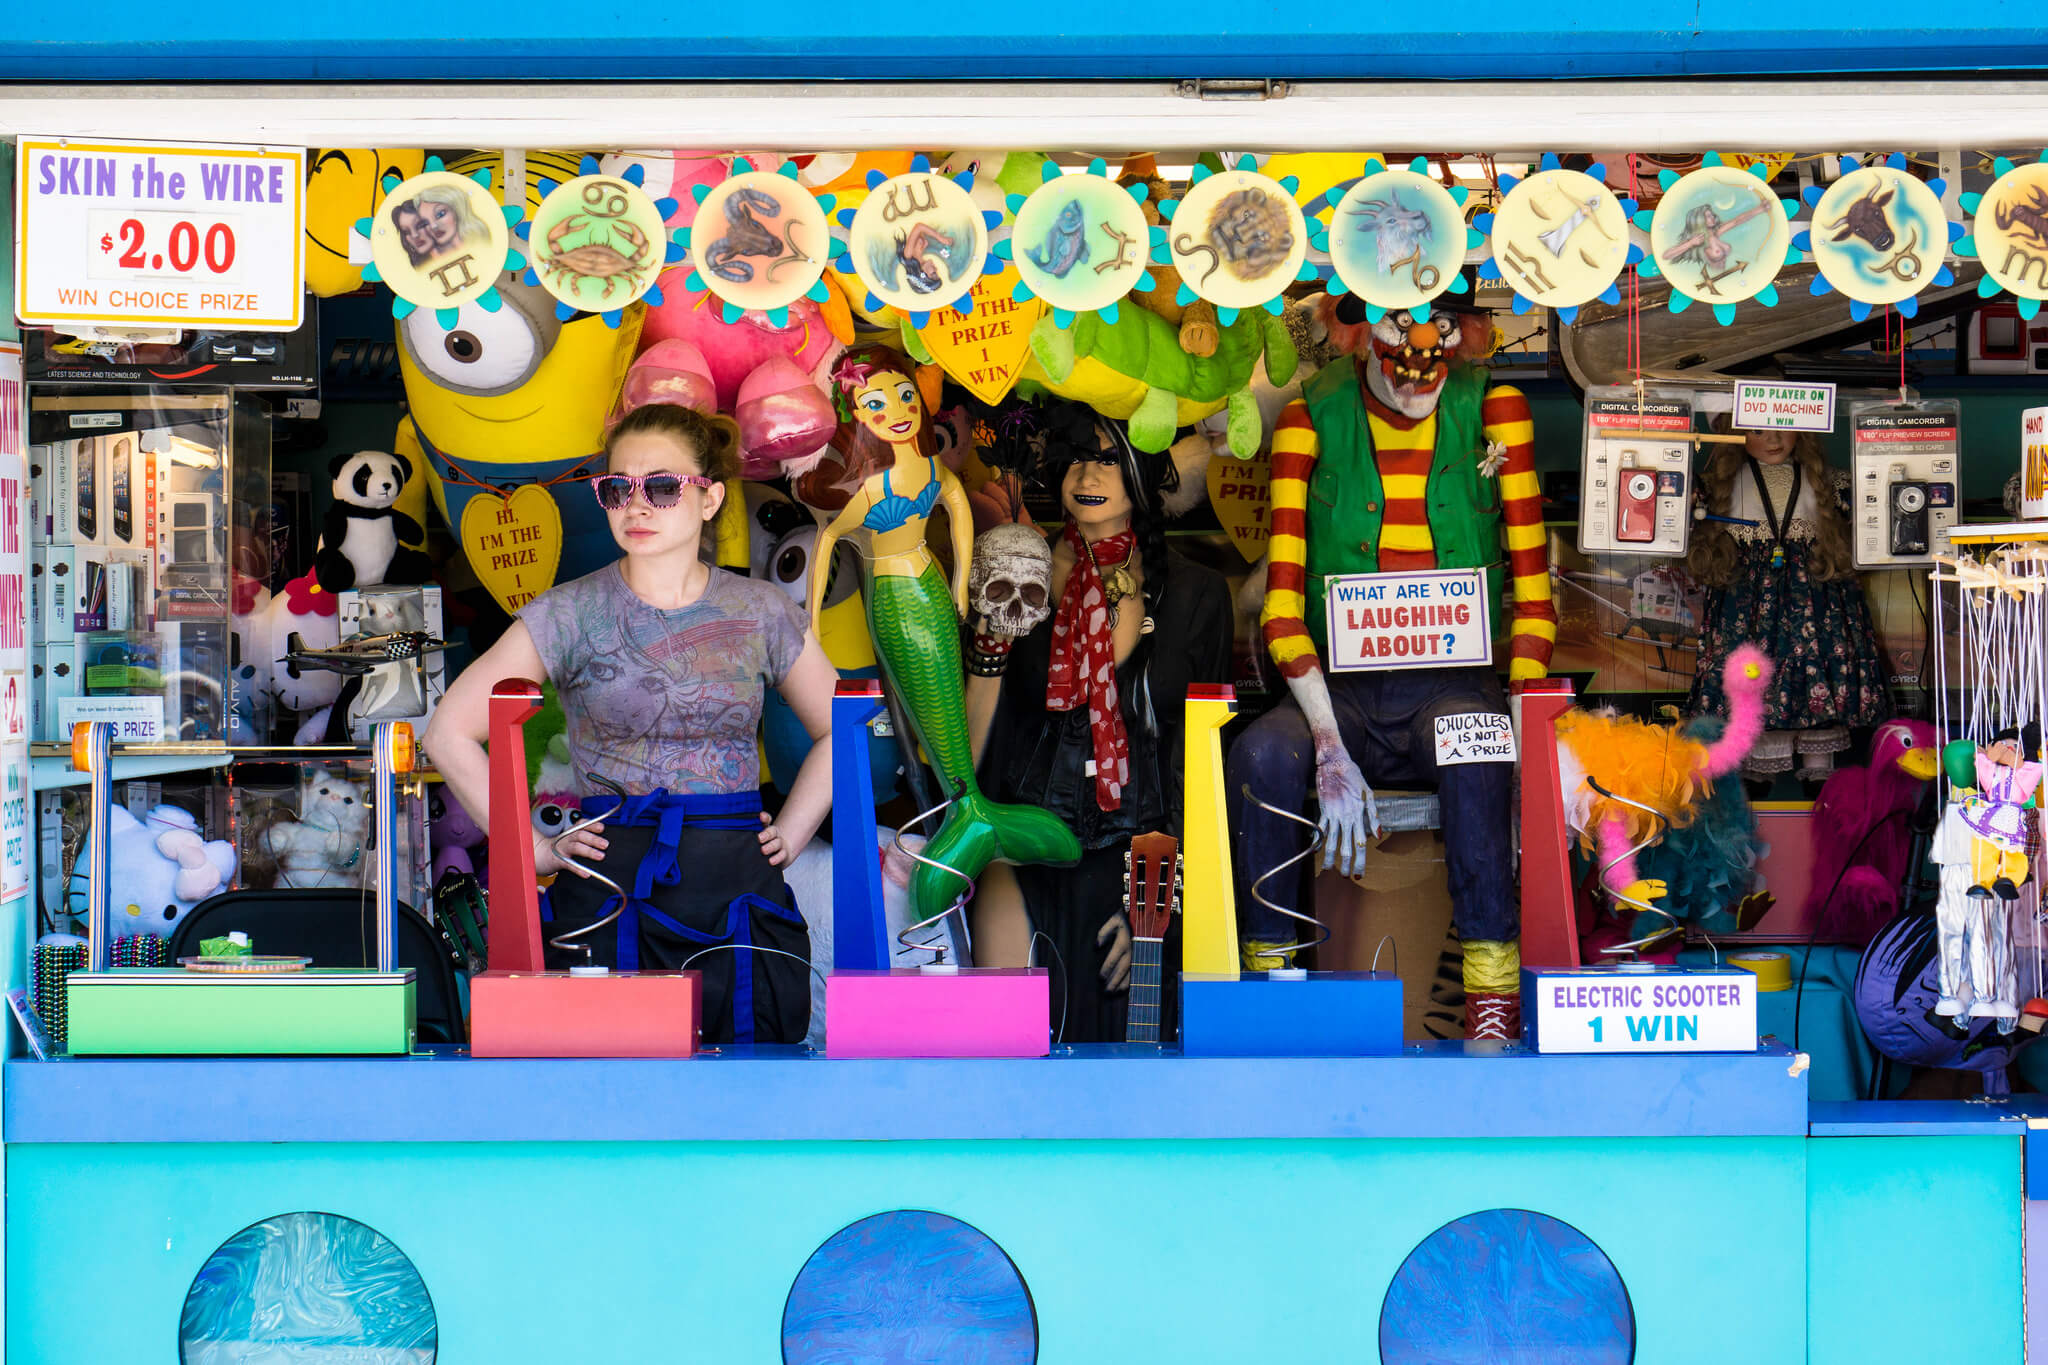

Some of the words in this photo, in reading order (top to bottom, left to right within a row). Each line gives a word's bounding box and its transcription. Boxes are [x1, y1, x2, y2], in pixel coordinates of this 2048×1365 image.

[39, 155, 116, 197] SKIN
[132, 157, 185, 200] the
[200, 163, 284, 203] WIRE
[100, 218, 236, 273] $2.00
[58, 287, 98, 306] WIN
[109, 290, 189, 309] CHOICE
[200, 293, 259, 311] PRIZE
[977, 296, 1019, 317] THE
[952, 320, 1013, 346] PRIZE
[48, 370, 67, 378] LATEST
[68, 371, 91, 379] SCIENCE
[105, 371, 141, 379] TECHNOLOGY
[968, 364, 1009, 385] WIN
[1745, 387, 1765, 398] DVD
[1769, 388, 1806, 400] PLAYER
[1811, 390, 1825, 401] ON
[1601, 403, 1629, 411] DIGITAL
[1744, 402, 1767, 413] DVD
[1773, 402, 1824, 415] MACHINE
[1776, 417, 1794, 425] WIN
[1867, 418, 1895, 426] DIGITAL
[1897, 417, 1945, 425] CAMCORDER
[2025, 415, 2043, 434] HAND
[1219, 465, 1255, 479] I'M
[1219, 482, 1270, 501] PRI
[1, 479, 18, 554] THE
[496, 509, 519, 525] HI,
[1252, 506, 1264, 522] 1
[480, 532, 504, 551] I'M
[509, 525, 542, 545] THE
[491, 548, 538, 571] PRIZE
[1338, 586, 1387, 602] WHAT
[1396, 584, 1431, 599] ARE
[1440, 581, 1475, 597] YOU
[0, 574, 23, 649] WIRE
[1347, 603, 1470, 630] LAUGHING
[1360, 633, 1456, 658] ABOUT?
[1890, 675, 1919, 683] GYRO
[231, 678, 240, 729] AUVIO
[124, 721, 156, 737] PRIZE
[1436, 714, 1509, 735] CHUCKLES
[1458, 732, 1471, 743] IS
[1475, 730, 1499, 741] NOT
[1446, 747, 1464, 760] A
[1467, 743, 1511, 756] PRIZE
[3, 798, 24, 829] CHOICE
[7, 837, 21, 866] PRIZE
[1554, 985, 1643, 1008] ELECTRIC
[1653, 984, 1741, 1008] SCOOTER
[1587, 1016, 1603, 1043] 1
[1625, 1014, 1698, 1042] WIN
